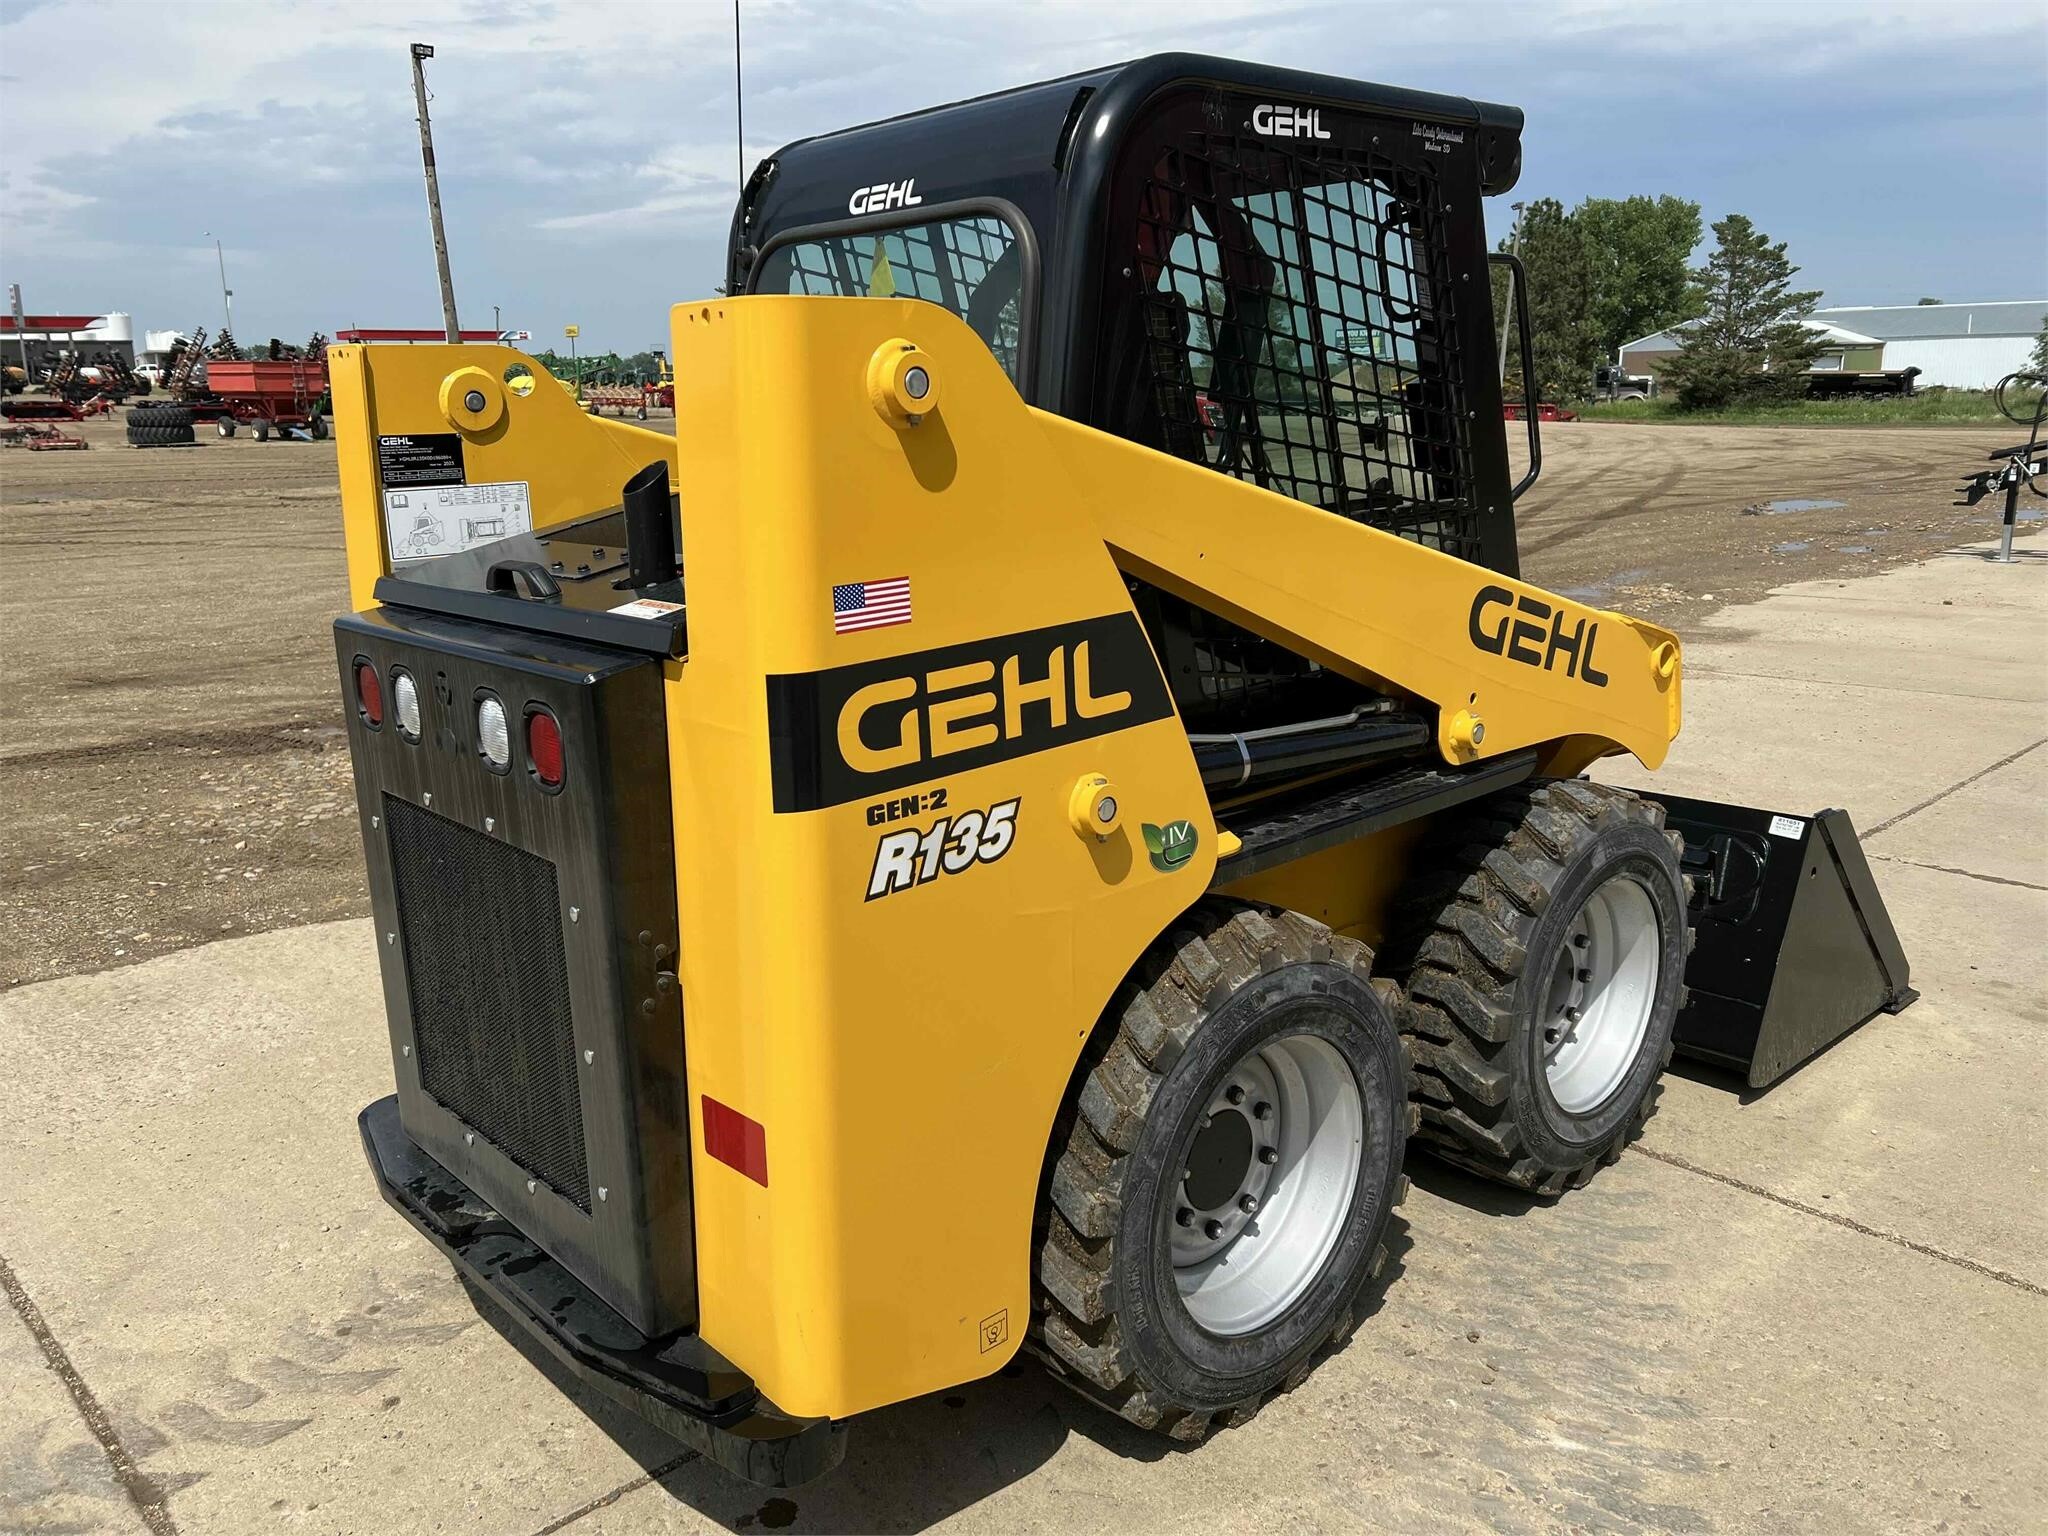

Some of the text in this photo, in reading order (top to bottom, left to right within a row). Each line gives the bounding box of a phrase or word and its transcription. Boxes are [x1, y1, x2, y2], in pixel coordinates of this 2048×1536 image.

[1253, 104, 1331, 139] GEHL
[849, 178, 922, 215] GEHL
[380, 436, 414, 446] GEHL
[1469, 585, 1609, 688] GEHL
[836, 639, 1133, 774] GEHL
[866, 788, 948, 827] GEN:2
[864, 796, 1022, 903] R135
[1169, 821, 1190, 845] IV
